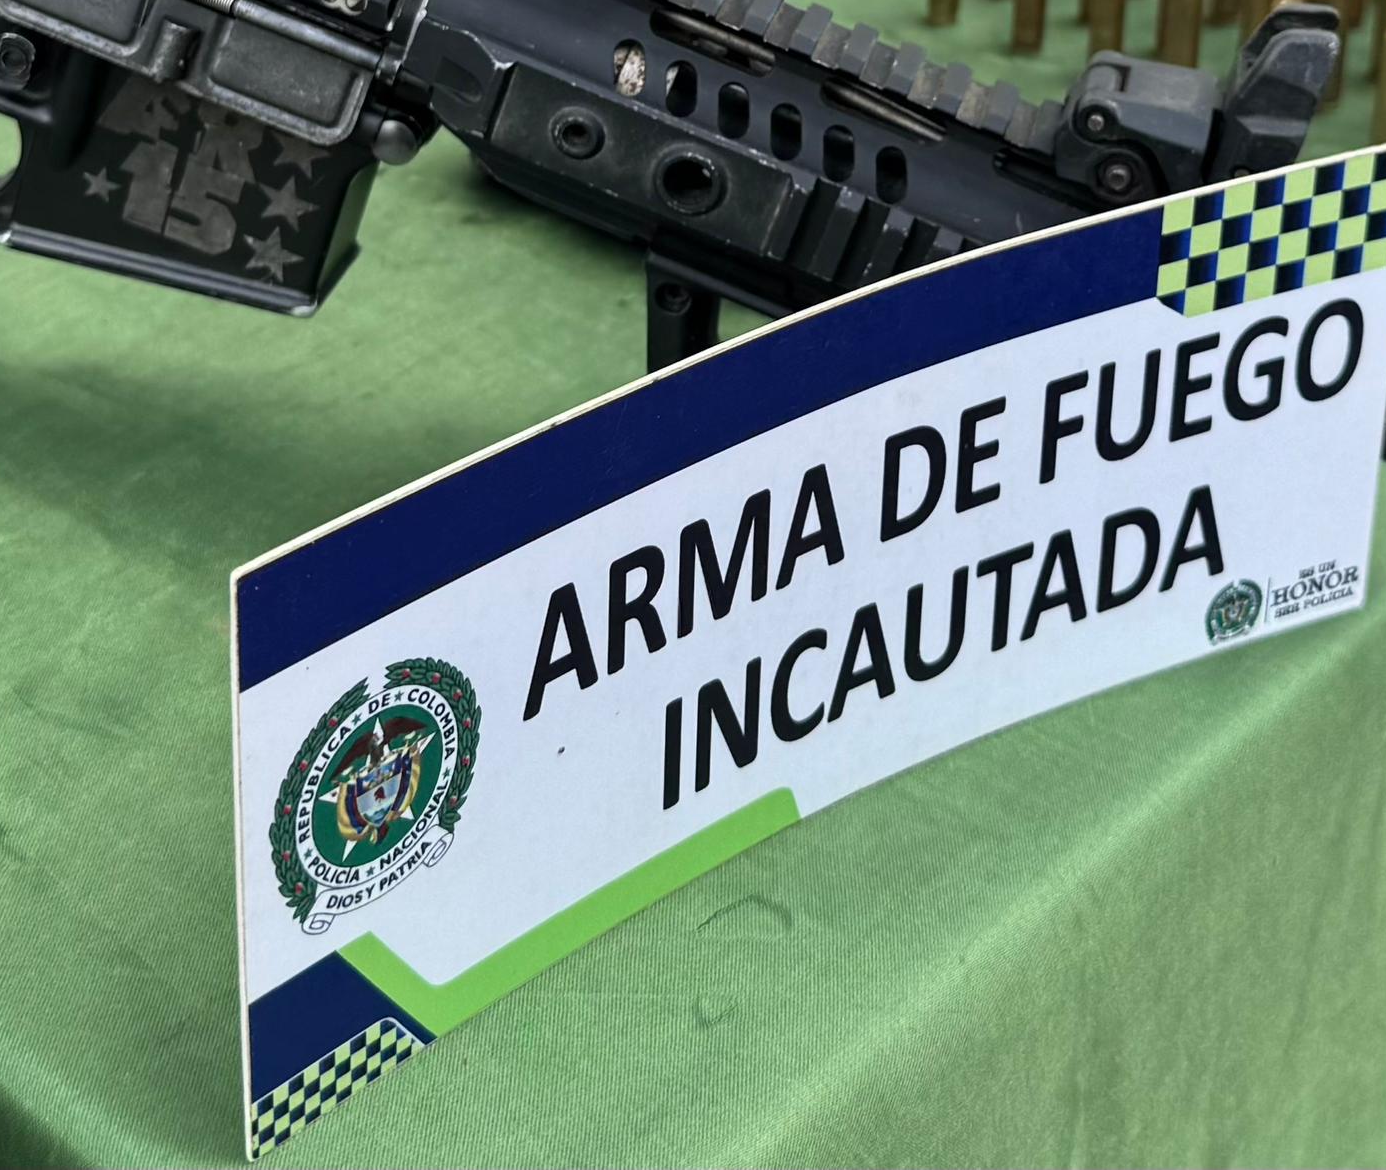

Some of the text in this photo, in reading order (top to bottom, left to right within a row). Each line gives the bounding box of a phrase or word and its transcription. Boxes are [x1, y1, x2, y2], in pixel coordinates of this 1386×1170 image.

[523, 297, 1364, 721] ARMA DE FUEGO
[1270, 565, 1359, 607] HONOR
[1319, 560, 1335, 573] UN
[662, 485, 1225, 811] INCAUTADA
[298, 688, 456, 844] REPUBLICA DE COLOMBIA
[379, 779, 449, 872] NACIONAL
[325, 839, 432, 910] DIOS Y PATRIA
